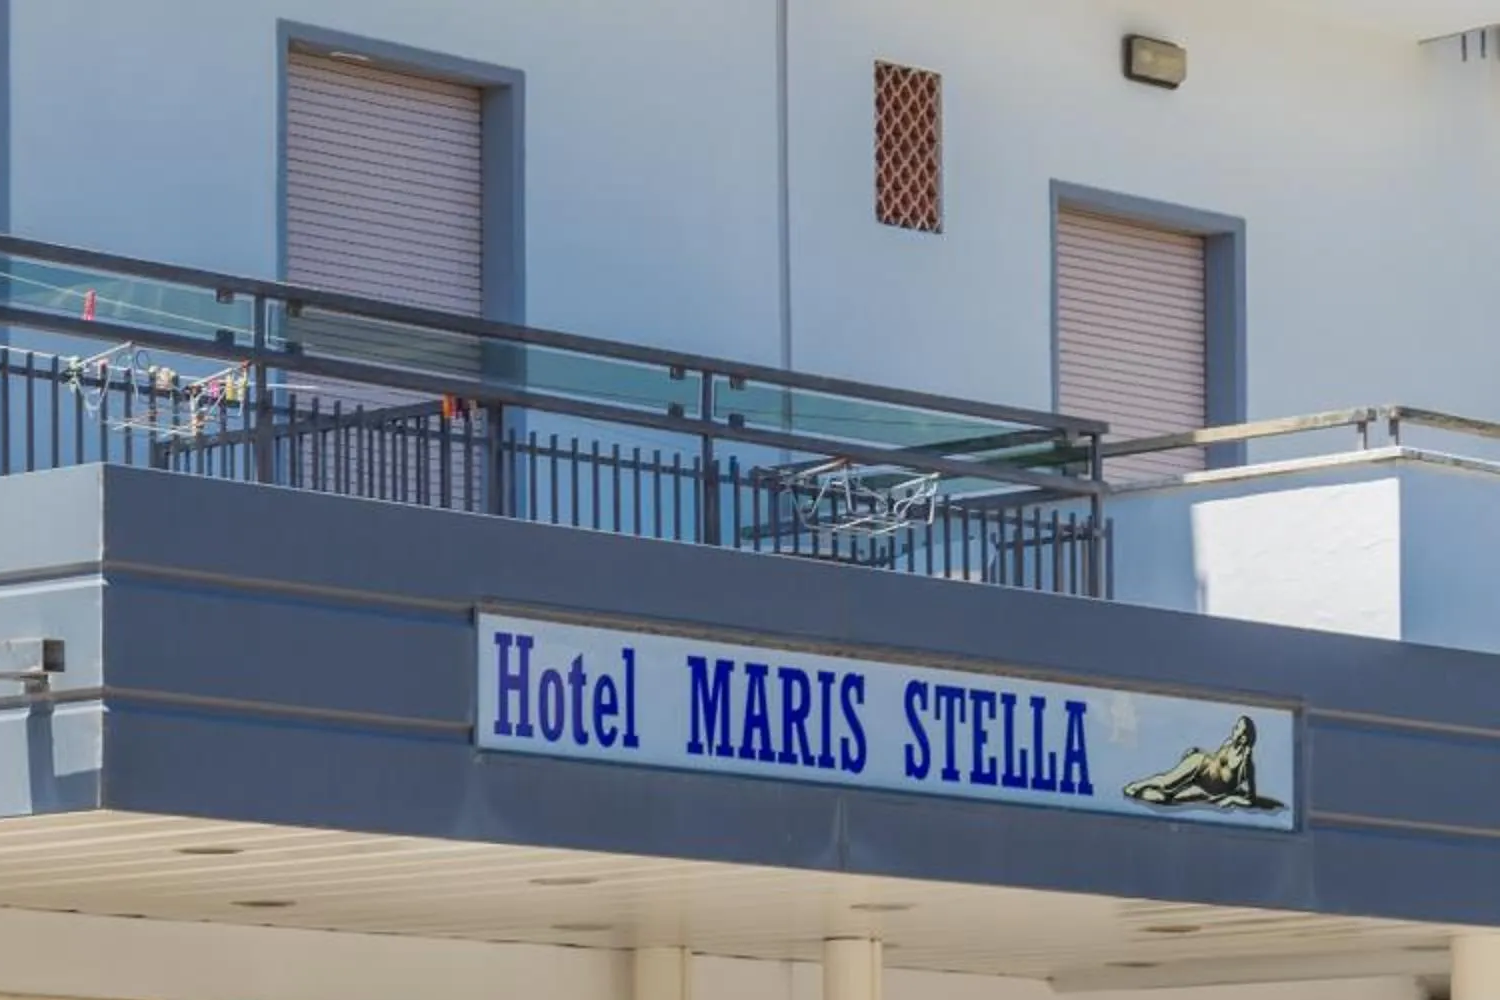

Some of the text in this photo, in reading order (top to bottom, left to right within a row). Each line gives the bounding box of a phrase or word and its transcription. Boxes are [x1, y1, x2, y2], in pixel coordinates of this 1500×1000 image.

[494, 632, 1093, 796] Hotel MARIS STELLA
